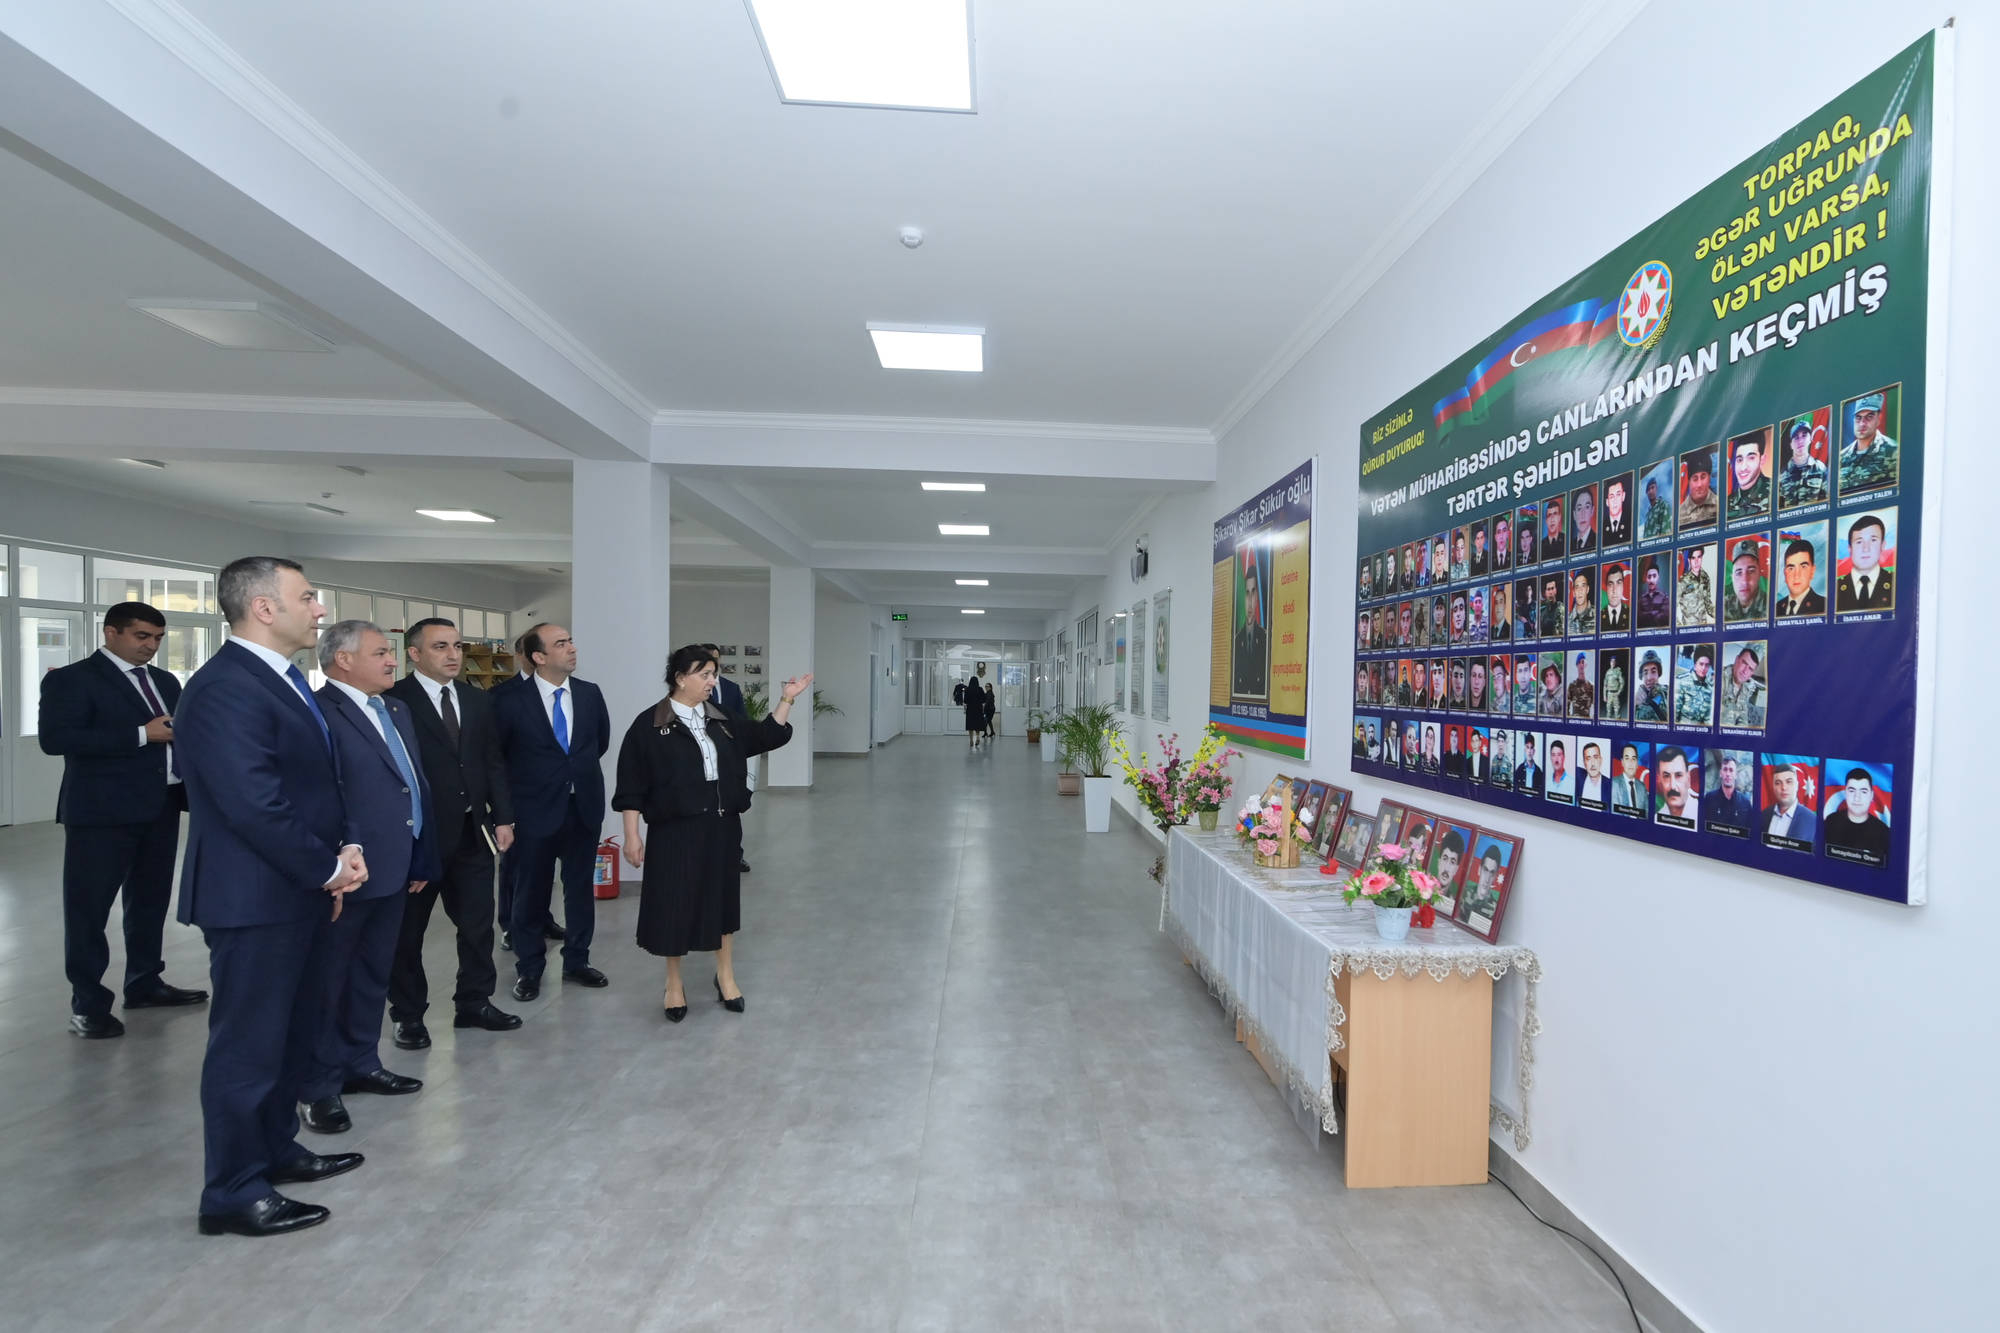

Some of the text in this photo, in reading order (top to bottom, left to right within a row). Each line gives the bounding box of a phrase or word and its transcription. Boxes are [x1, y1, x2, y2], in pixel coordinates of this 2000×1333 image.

[1695, 114, 1913, 260] ƏGƏR UĞRUNDA
[1743, 115, 1861, 200] TORPAQ,
[1711, 173, 1890, 284] ÖLƏN VARSA,
[1712, 222, 1866, 320] VƏTƏNDİR
[1371, 264, 1888, 517] VƏTƏN MÜHARİBƏSİNDƏ CANLARINDAN KEÇMİŞ
[1372, 408, 1414, 445] BİZ SİZİNLƏ
[1386, 429, 1424, 463] DUYURUQ!
[1447, 422, 1629, 517] TƏRTƏR ŞƏHİDLƏRİ
[1259, 490, 1286, 524] Şükür
[1287, 474, 1311, 505] oğlu
